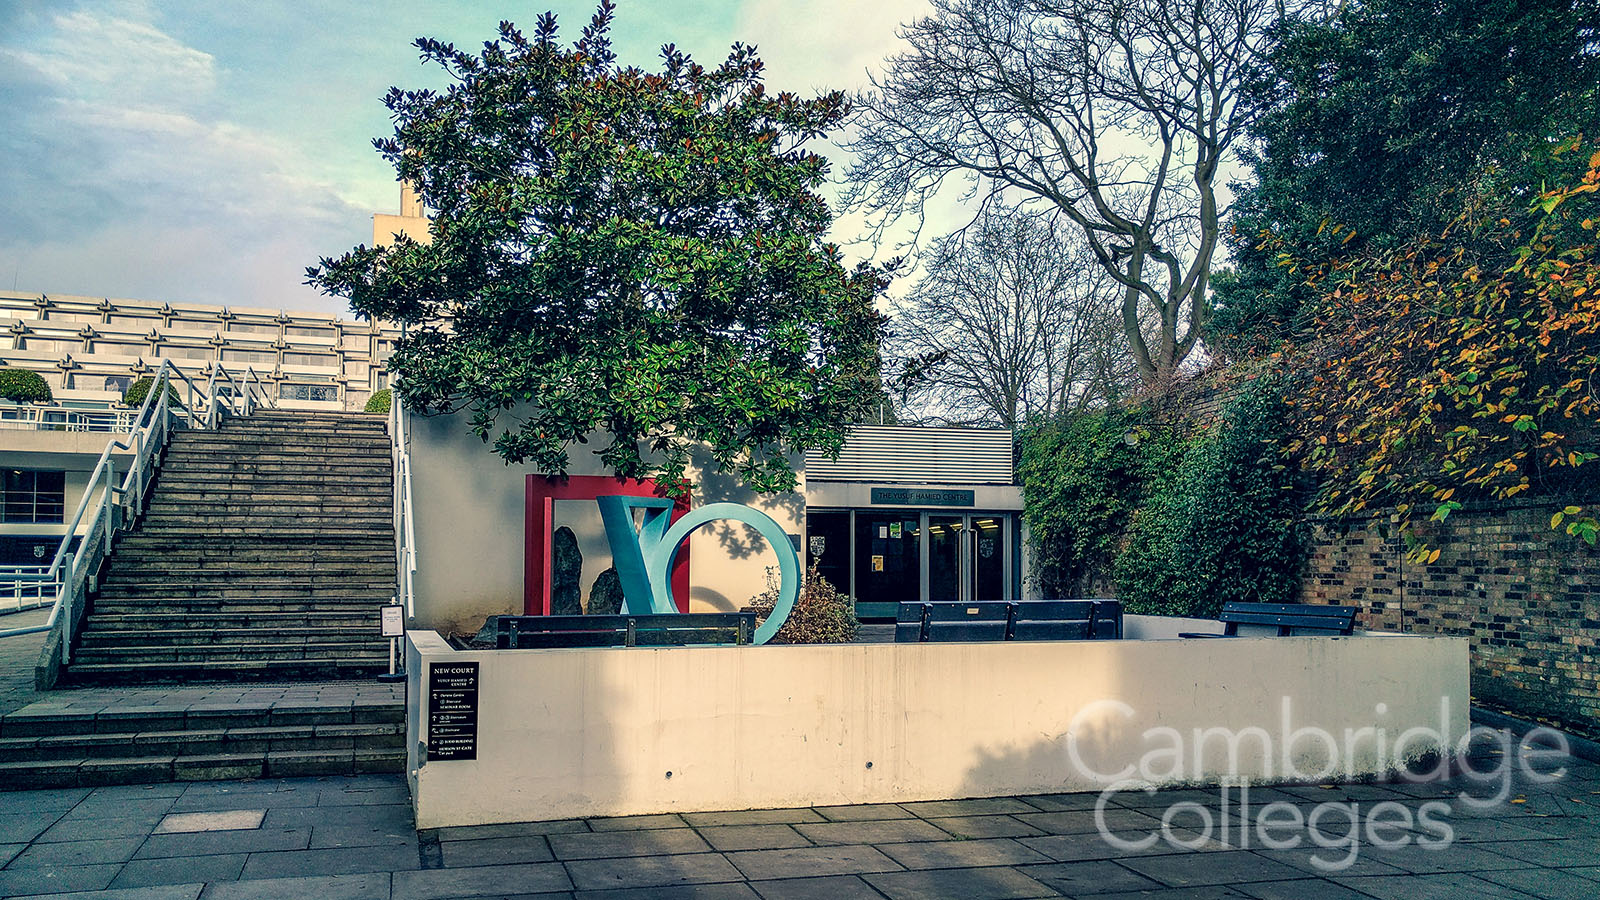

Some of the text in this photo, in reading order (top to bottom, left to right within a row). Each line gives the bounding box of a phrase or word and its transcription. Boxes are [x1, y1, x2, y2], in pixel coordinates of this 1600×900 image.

[878, 492, 968, 502] THE YUSUF HAMIED CENTRE
